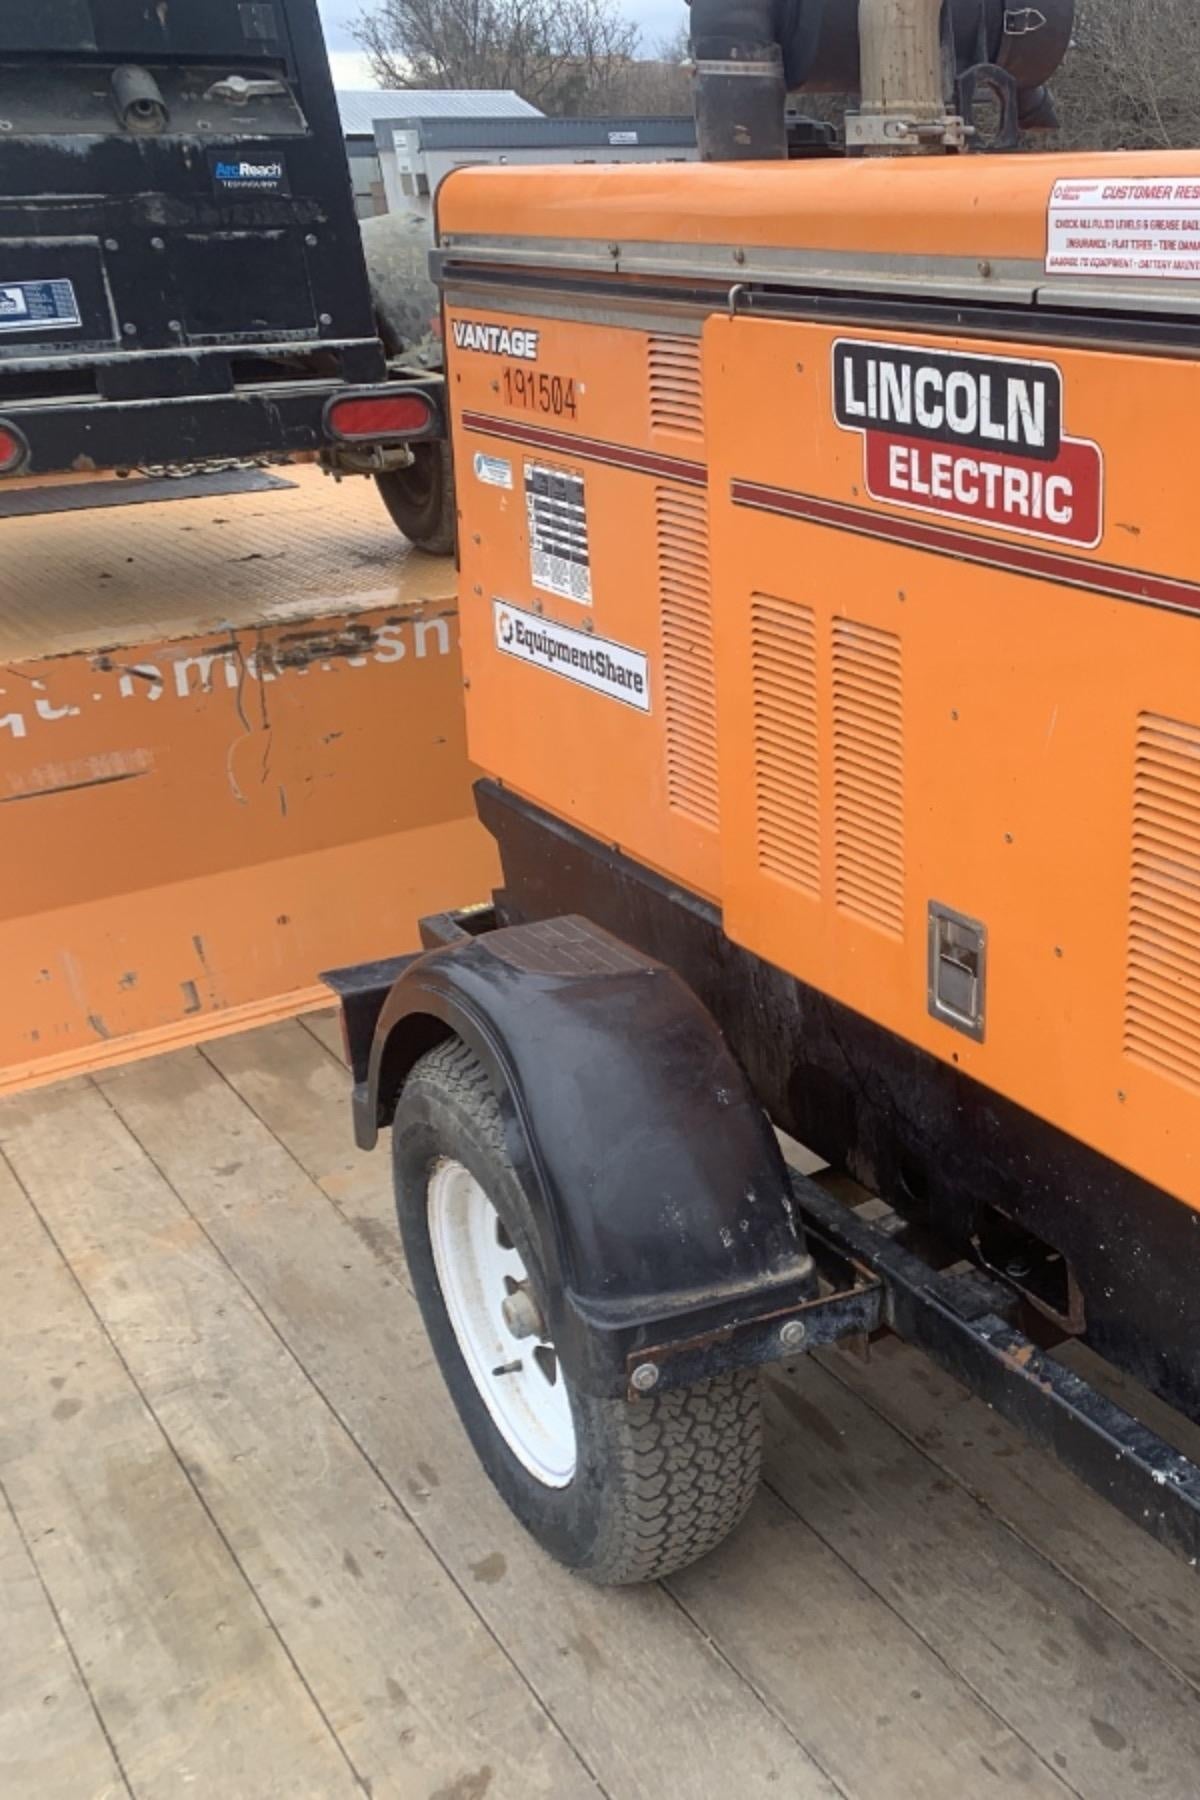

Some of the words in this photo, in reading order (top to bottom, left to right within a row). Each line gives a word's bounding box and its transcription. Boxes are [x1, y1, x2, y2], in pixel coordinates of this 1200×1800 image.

[216, 161, 281, 178] ArcReach
[1101, 184, 1174, 201] CUSTOMER
[451, 320, 539, 359] VANTAGE
[503, 368, 577, 419] 191504
[842, 356, 1046, 448] LINCOLN
[888, 444, 1073, 526] ELECTRIC
[513, 617, 645, 695] EquipmentShare
